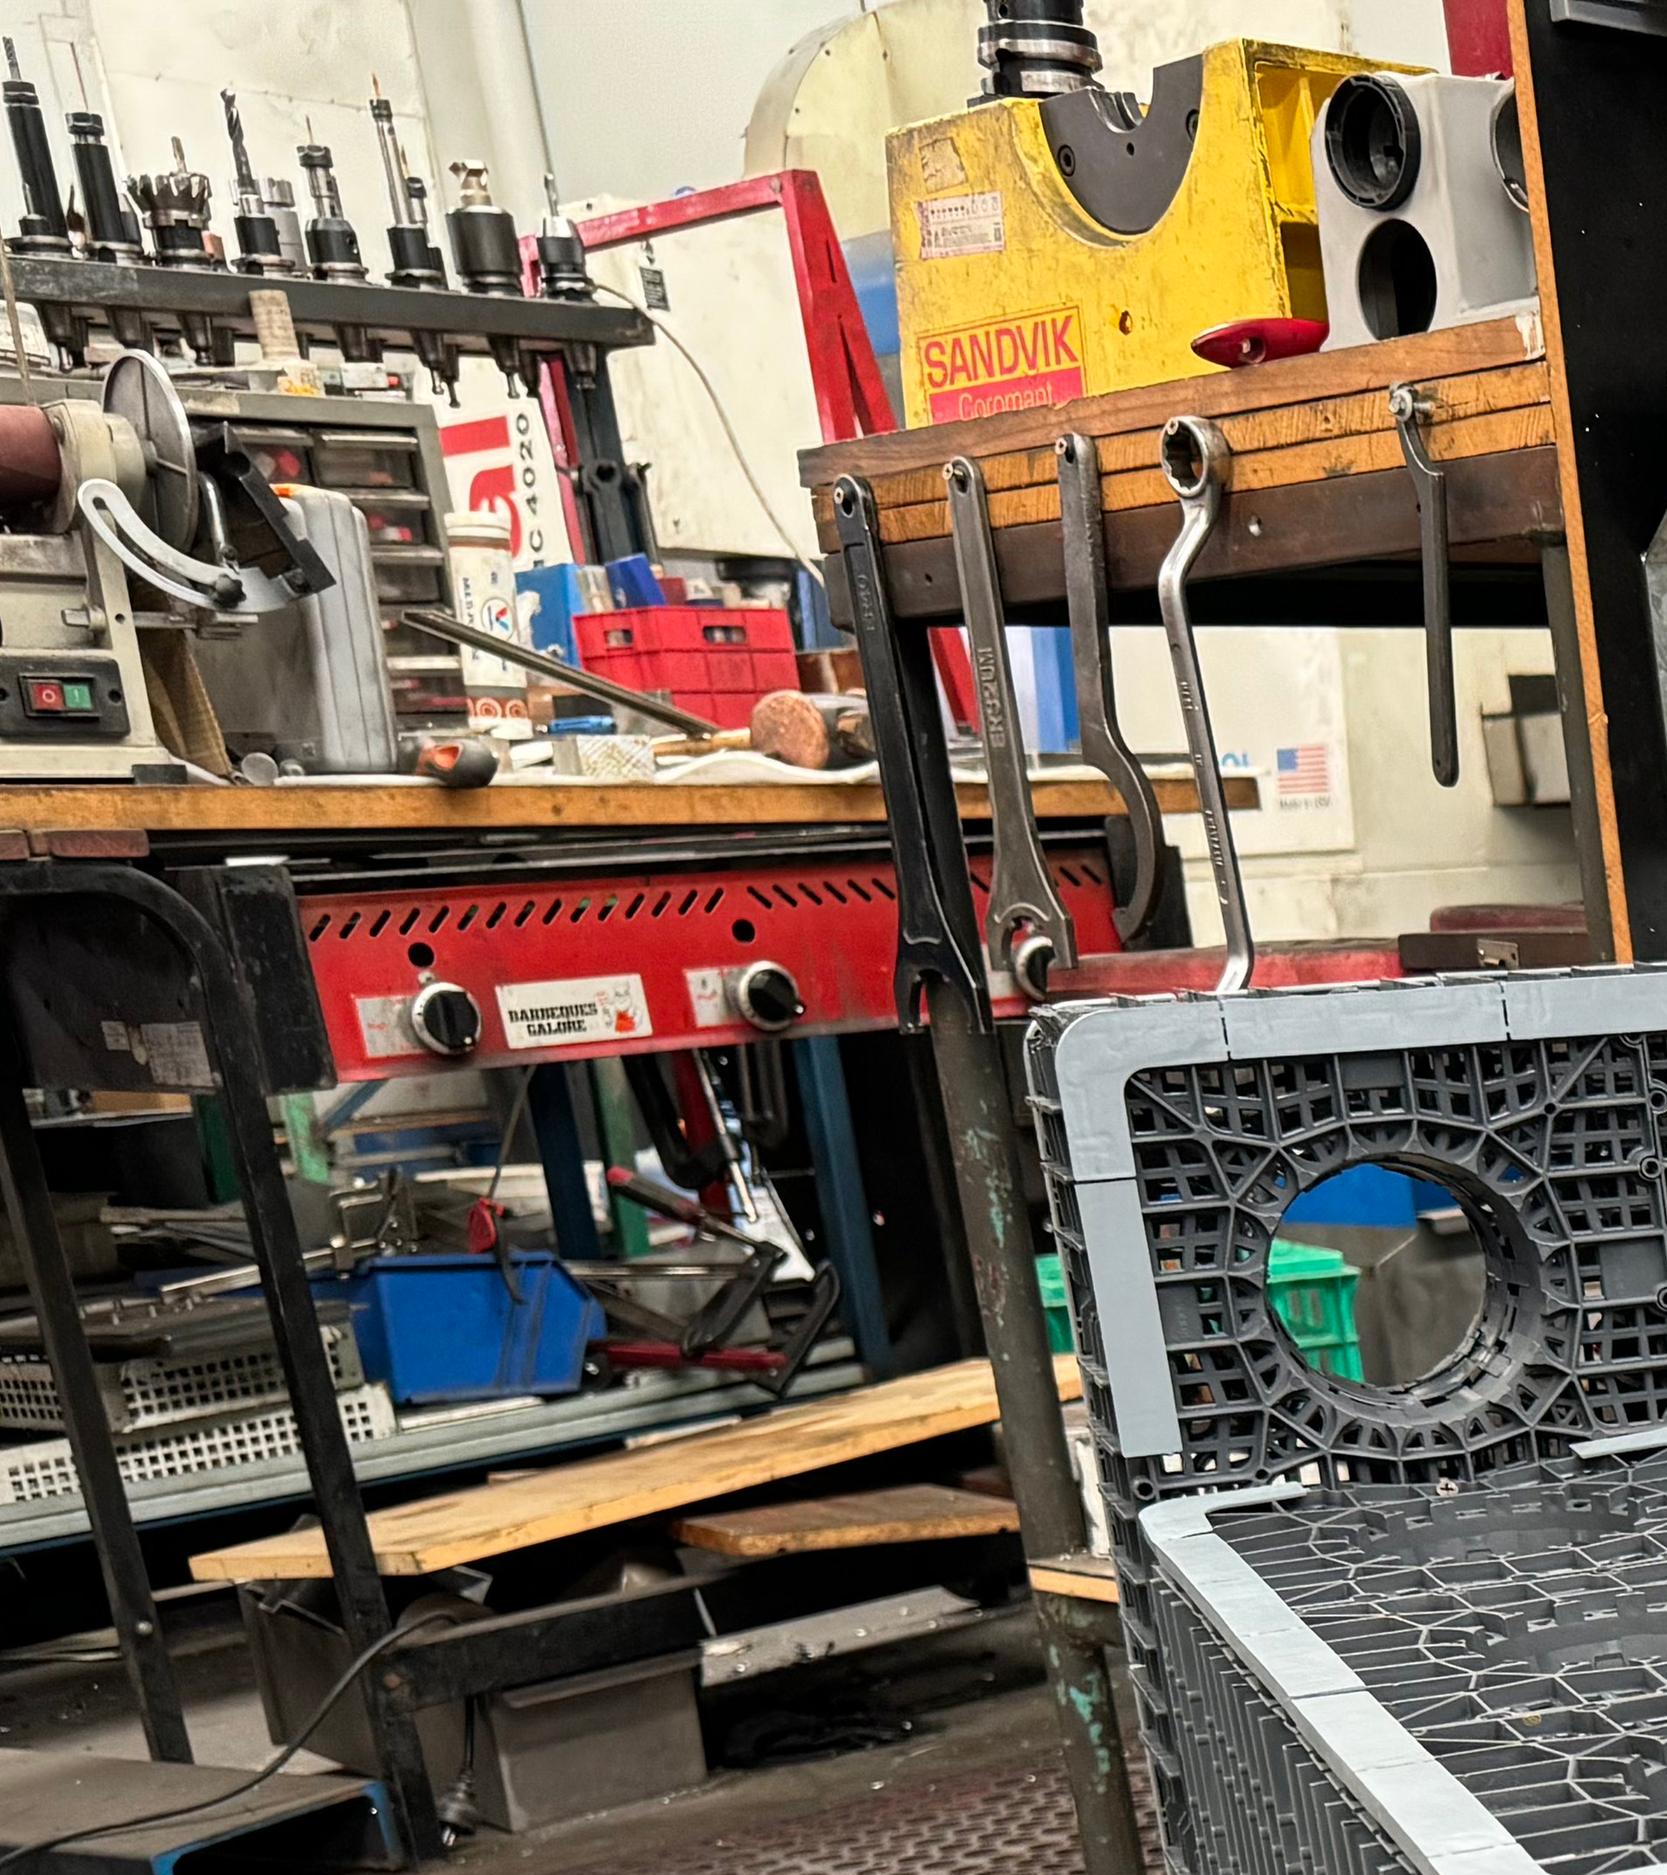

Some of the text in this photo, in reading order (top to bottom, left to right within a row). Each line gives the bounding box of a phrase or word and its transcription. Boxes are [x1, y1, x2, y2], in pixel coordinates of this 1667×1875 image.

[924, 315, 1080, 389] SANDVIK
[516, 413, 538, 516] 4020
[526, 1019, 588, 1038] GALORE
